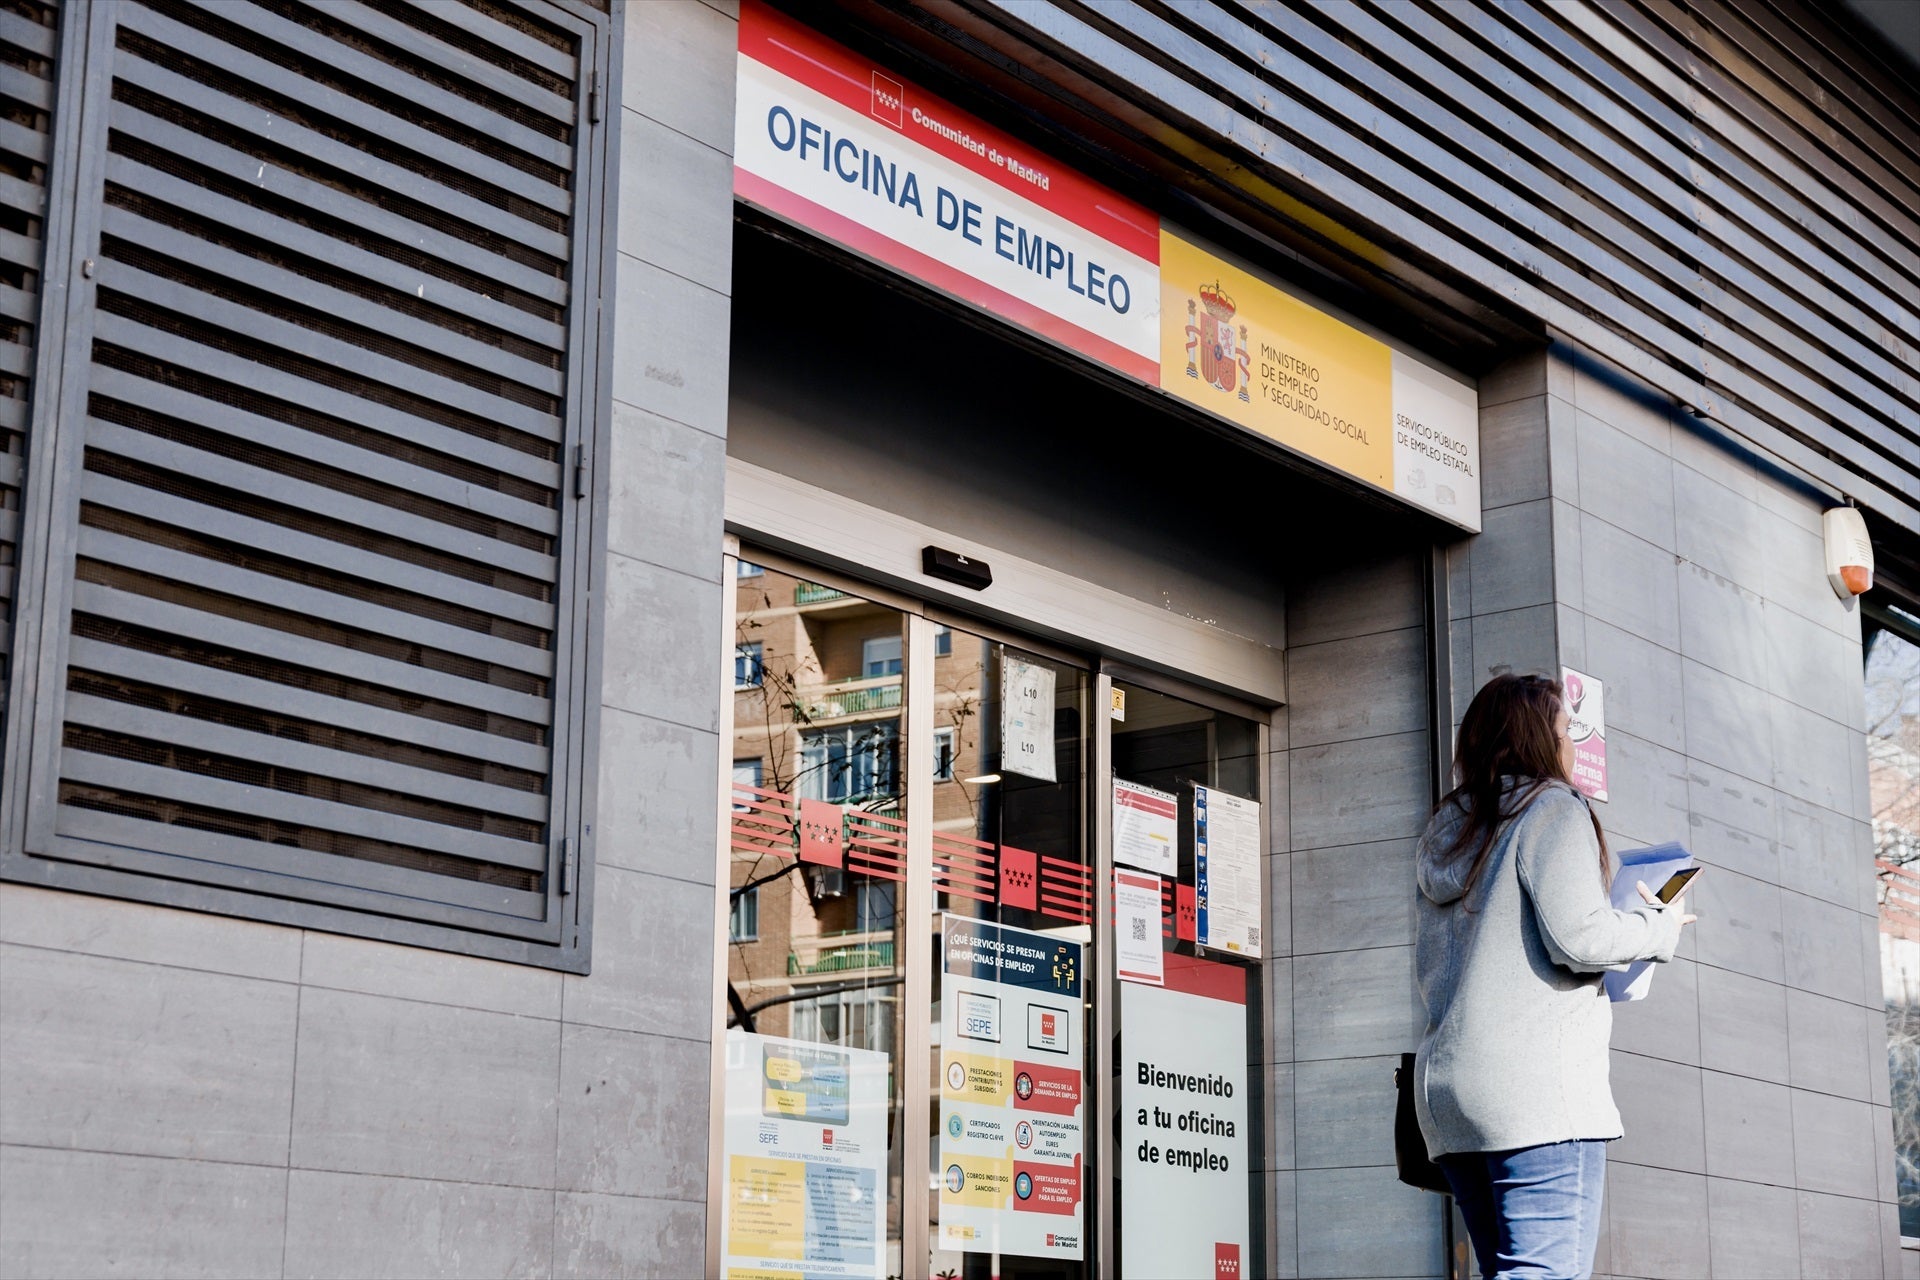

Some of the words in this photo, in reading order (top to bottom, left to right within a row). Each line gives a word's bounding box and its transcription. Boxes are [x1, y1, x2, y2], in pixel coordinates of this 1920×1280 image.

[911, 107, 985, 158] Comunidad
[989, 148, 1004, 167] de
[1007, 158, 1049, 191] Madrid
[768, 105, 923, 218] OFICINA
[937, 186, 982, 246] DE
[995, 215, 1130, 314] EMPLEO
[1261, 343, 1320, 383] MINISTERIO
[1261, 363, 1276, 382] DE
[1279, 370, 1318, 401] EMPLEO
[1261, 383, 1268, 398] Y
[1271, 387, 1330, 427] SEGURIDAD
[1333, 416, 1369, 445] SOCIAL
[1397, 413, 1432, 440] SERVICIO
[1434, 430, 1468, 457] PÚBLICO
[1397, 431, 1409, 447] DE
[1410, 437, 1441, 462] EMPLEO
[1443, 454, 1474, 478] ESTATAL
[1574, 759, 1603, 782] larma
[950, 933, 968, 945] ¿QUÉ
[969, 938, 1005, 952] SERVICIOS
[1006, 945, 1015, 955] SE
[1016, 946, 1045, 960] PRESTAN
[951, 949, 960, 959] EN
[962, 950, 994, 966] OFICINAS
[995, 957, 1004, 968] DE
[1005, 958, 1035, 974] EMPLEO?
[967, 1017, 991, 1035] SEPE
[970, 1068, 1002, 1078] PRESTACIONES
[1039, 1081, 1060, 1090] SERVICIOS
[1138, 1062, 1233, 1098] Bienvenido
[974, 1085, 996, 1093] SUBSIDIOS
[1035, 1088, 1055, 1096] DEMANDA
[1062, 1092, 1078, 1100] EMPLEO
[969, 1120, 1001, 1130] CERTIFICADOS
[1032, 1119, 1060, 1130] ORIENTACIÓN
[1061, 1123, 1079, 1132] LABORAL
[1138, 1108, 1147, 1126] a
[1154, 1106, 1171, 1129] tu
[1178, 1110, 1235, 1138] oficina
[759, 1133, 778, 1144] SEPE
[967, 1131, 988, 1140] REGISTRO
[1039, 1130, 1066, 1139] AUTOEMPLEO
[1056, 1151, 1072, 1160] JUVENIL
[1138, 1140, 1159, 1163] de
[1166, 1147, 1229, 1173] empleo
[966, 1172, 985, 1181] COBROS
[1034, 1175, 1053, 1184] OFERTAS
[1059, 1178, 1077, 1186] EMPLEO
[974, 1184, 1001, 1193] SANCIONES
[1042, 1185, 1068, 1195] FORMACIÓN
[1038, 1194, 1050, 1202] PARA
[1056, 1196, 1073, 1204] EMPLEO
[1054, 1234, 1078, 1243] Comunidad
